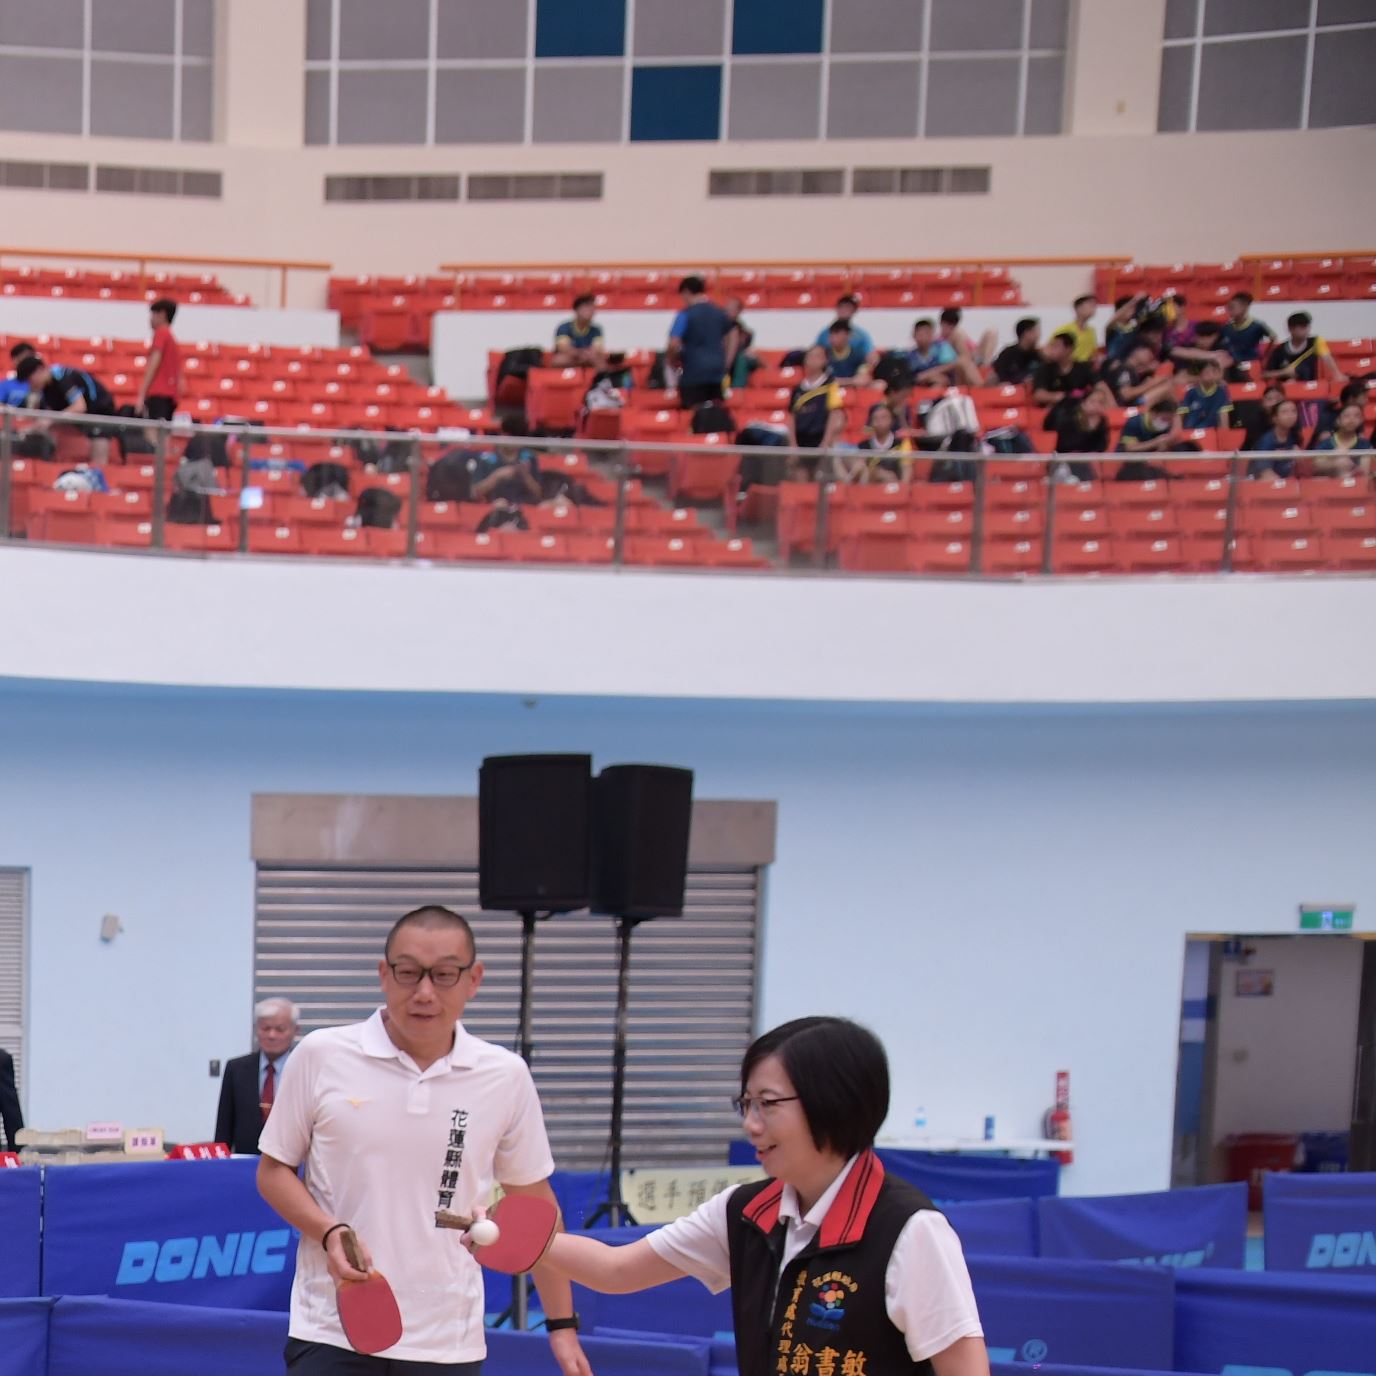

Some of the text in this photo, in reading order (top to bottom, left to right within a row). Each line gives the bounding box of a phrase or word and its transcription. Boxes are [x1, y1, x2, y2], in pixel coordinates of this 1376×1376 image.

[435, 1109, 469, 1228] 花蓮縣體育
[116, 1229, 290, 1285] DONIC
